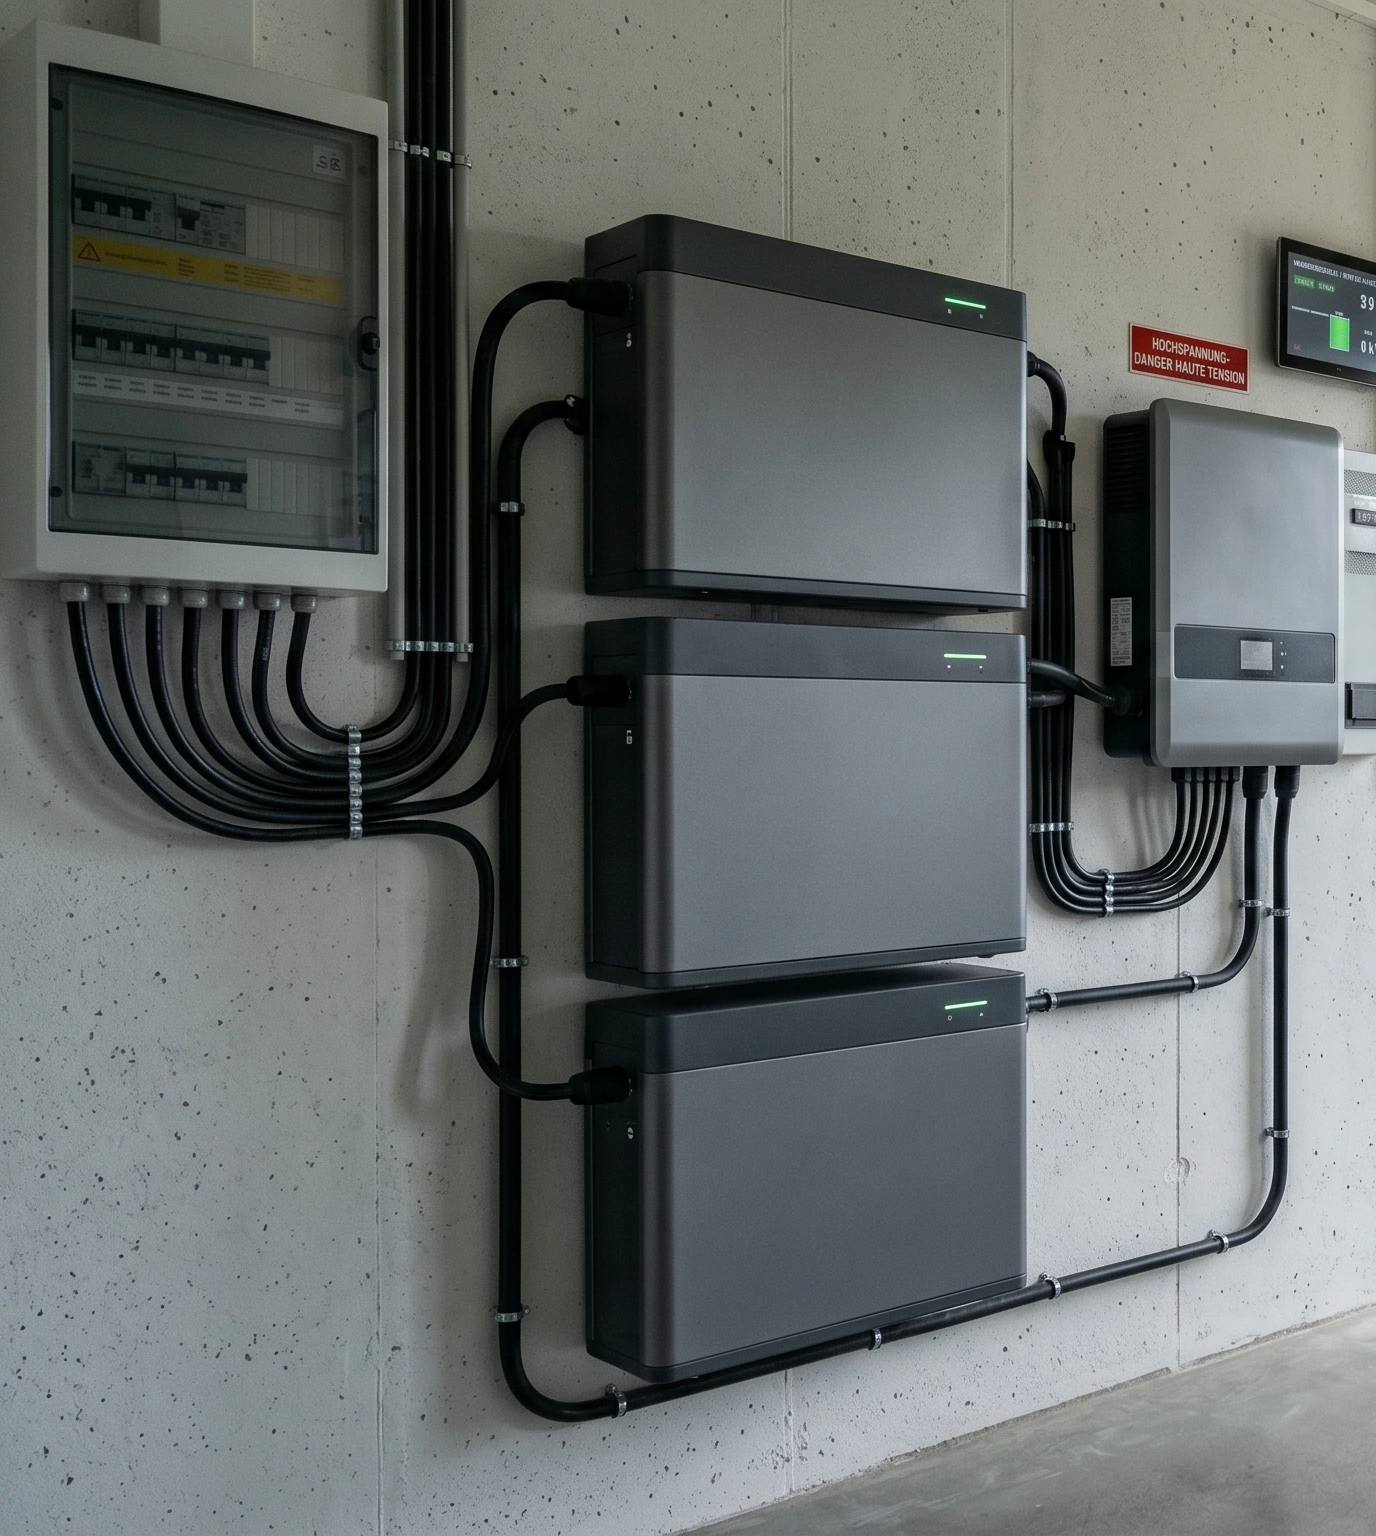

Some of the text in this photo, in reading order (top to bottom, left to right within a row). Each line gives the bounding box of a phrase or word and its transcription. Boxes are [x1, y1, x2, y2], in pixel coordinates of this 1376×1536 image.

[1152, 337, 1230, 364] HOCHSPANNUNG-
[1360, 340, 1367, 353] 0
[1134, 351, 1245, 385] DANGER HAUTE TENSION
